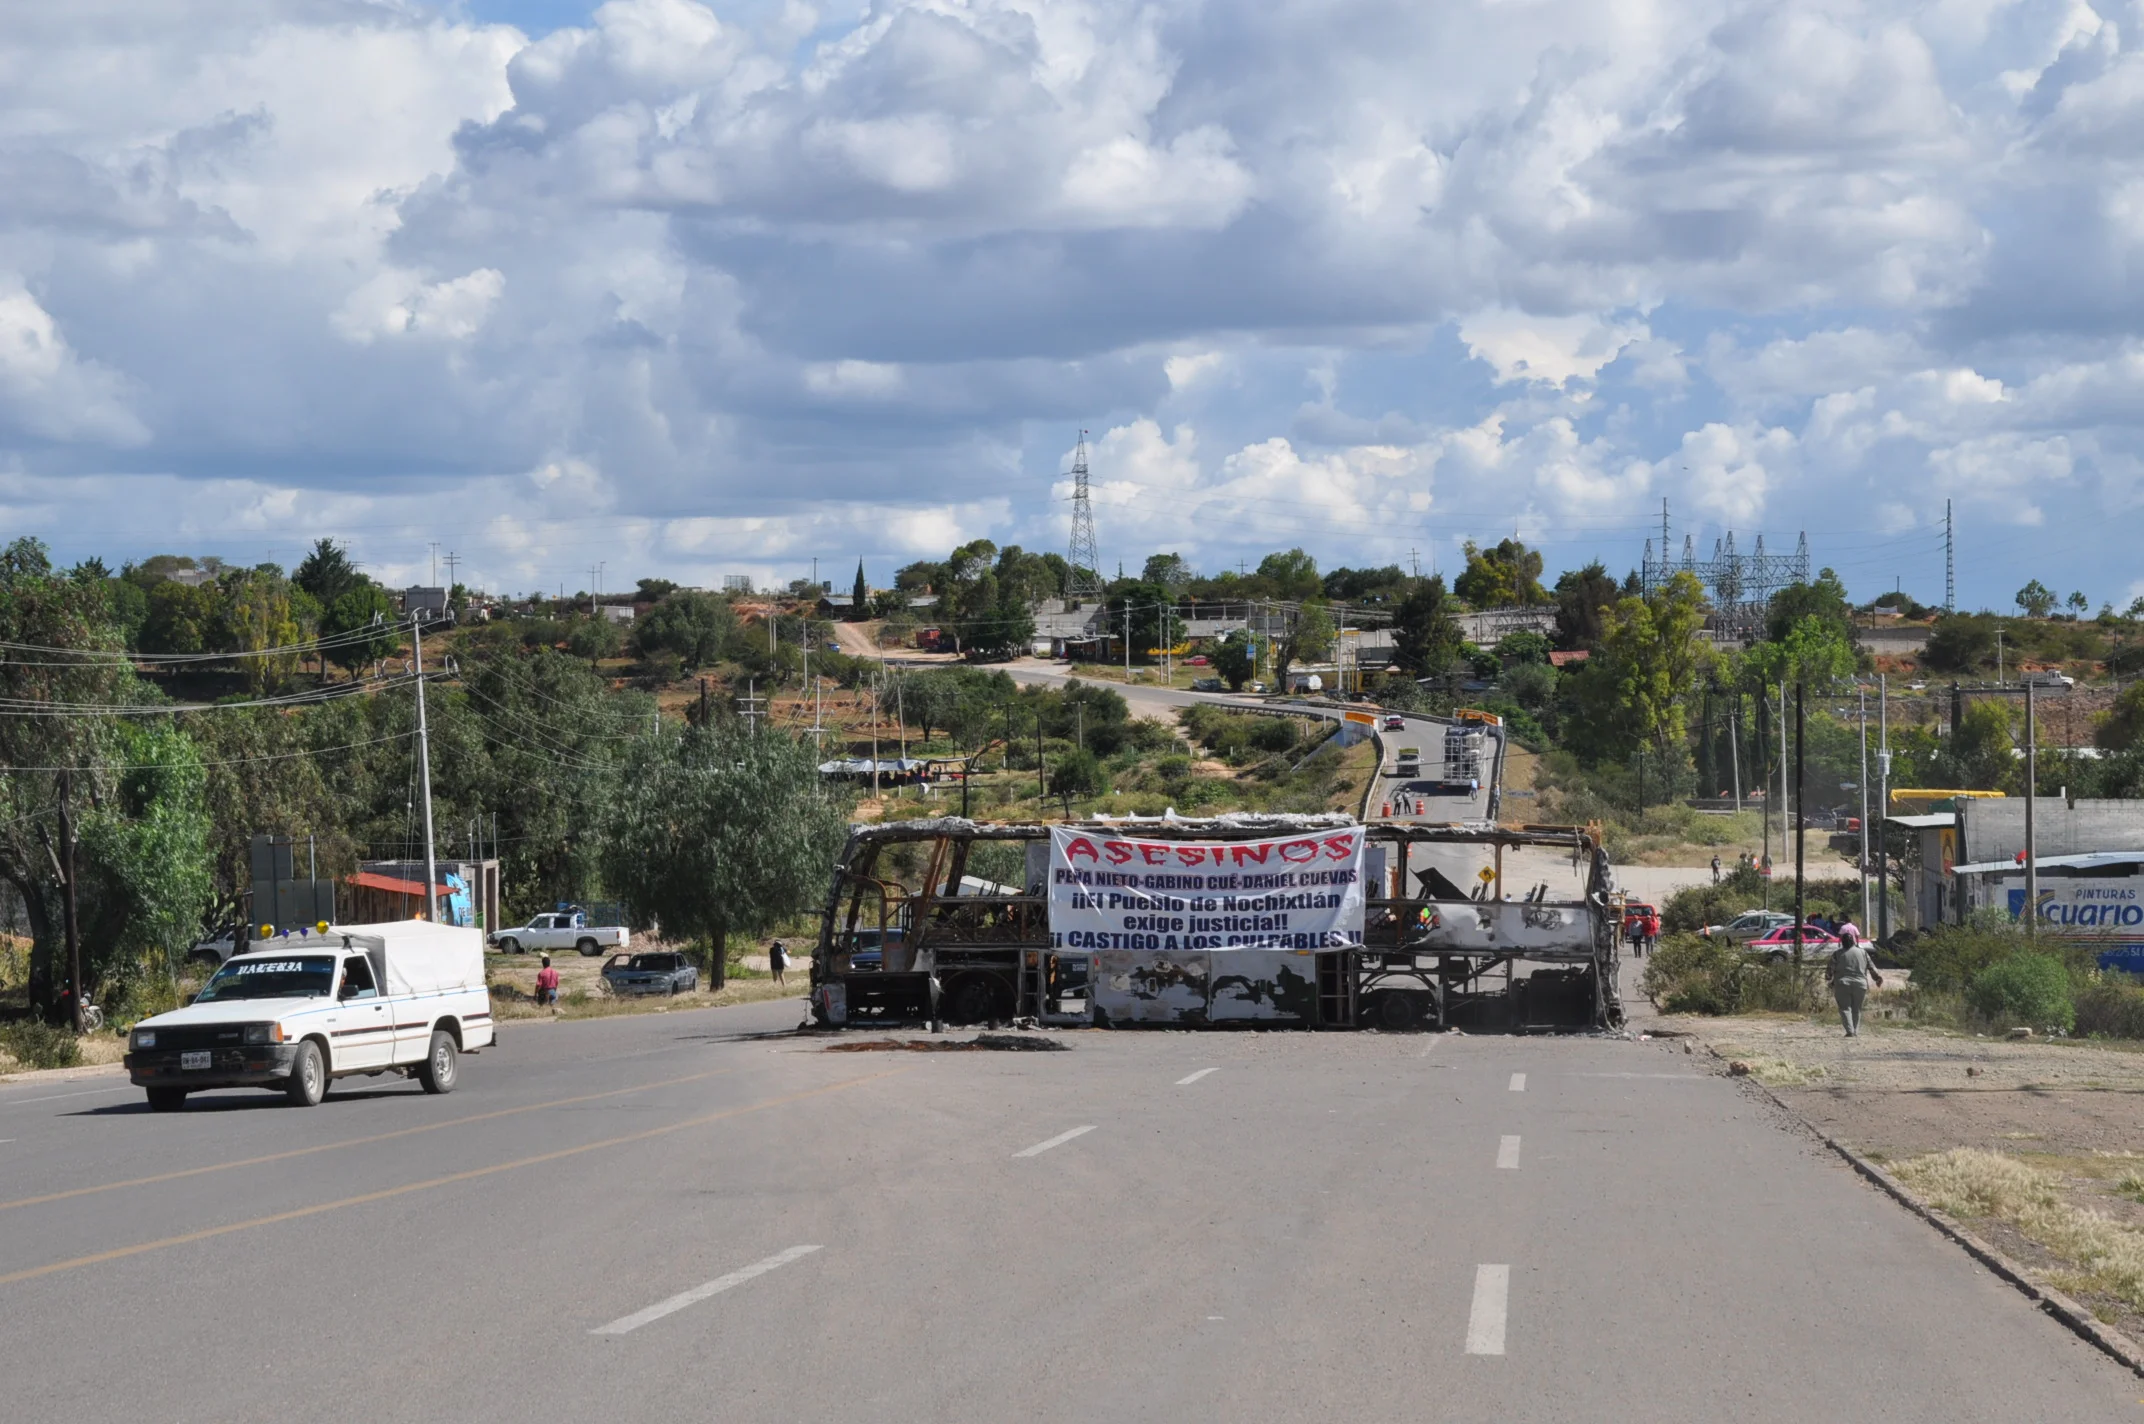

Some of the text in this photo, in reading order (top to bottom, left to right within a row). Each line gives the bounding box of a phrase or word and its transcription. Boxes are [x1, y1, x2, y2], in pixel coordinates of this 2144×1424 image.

[1066, 834, 1353, 868] ASESINOS
[1055, 867, 1357, 890] PEÑA NIETO-GABINO CUÉ-DANIEL CUEVAS
[1109, 893, 1185, 911] Pueblo
[1189, 896, 1217, 912] de
[1223, 891, 1341, 912] Nochixtlán
[2075, 889, 2136, 899] PINTURAS
[1123, 913, 1288, 933] exige justicia!!
[1068, 931, 1159, 949] CASTIGO
[1164, 935, 1179, 950] A
[1184, 935, 1222, 949] LOS
[1227, 930, 1343, 949] CULPABLES
